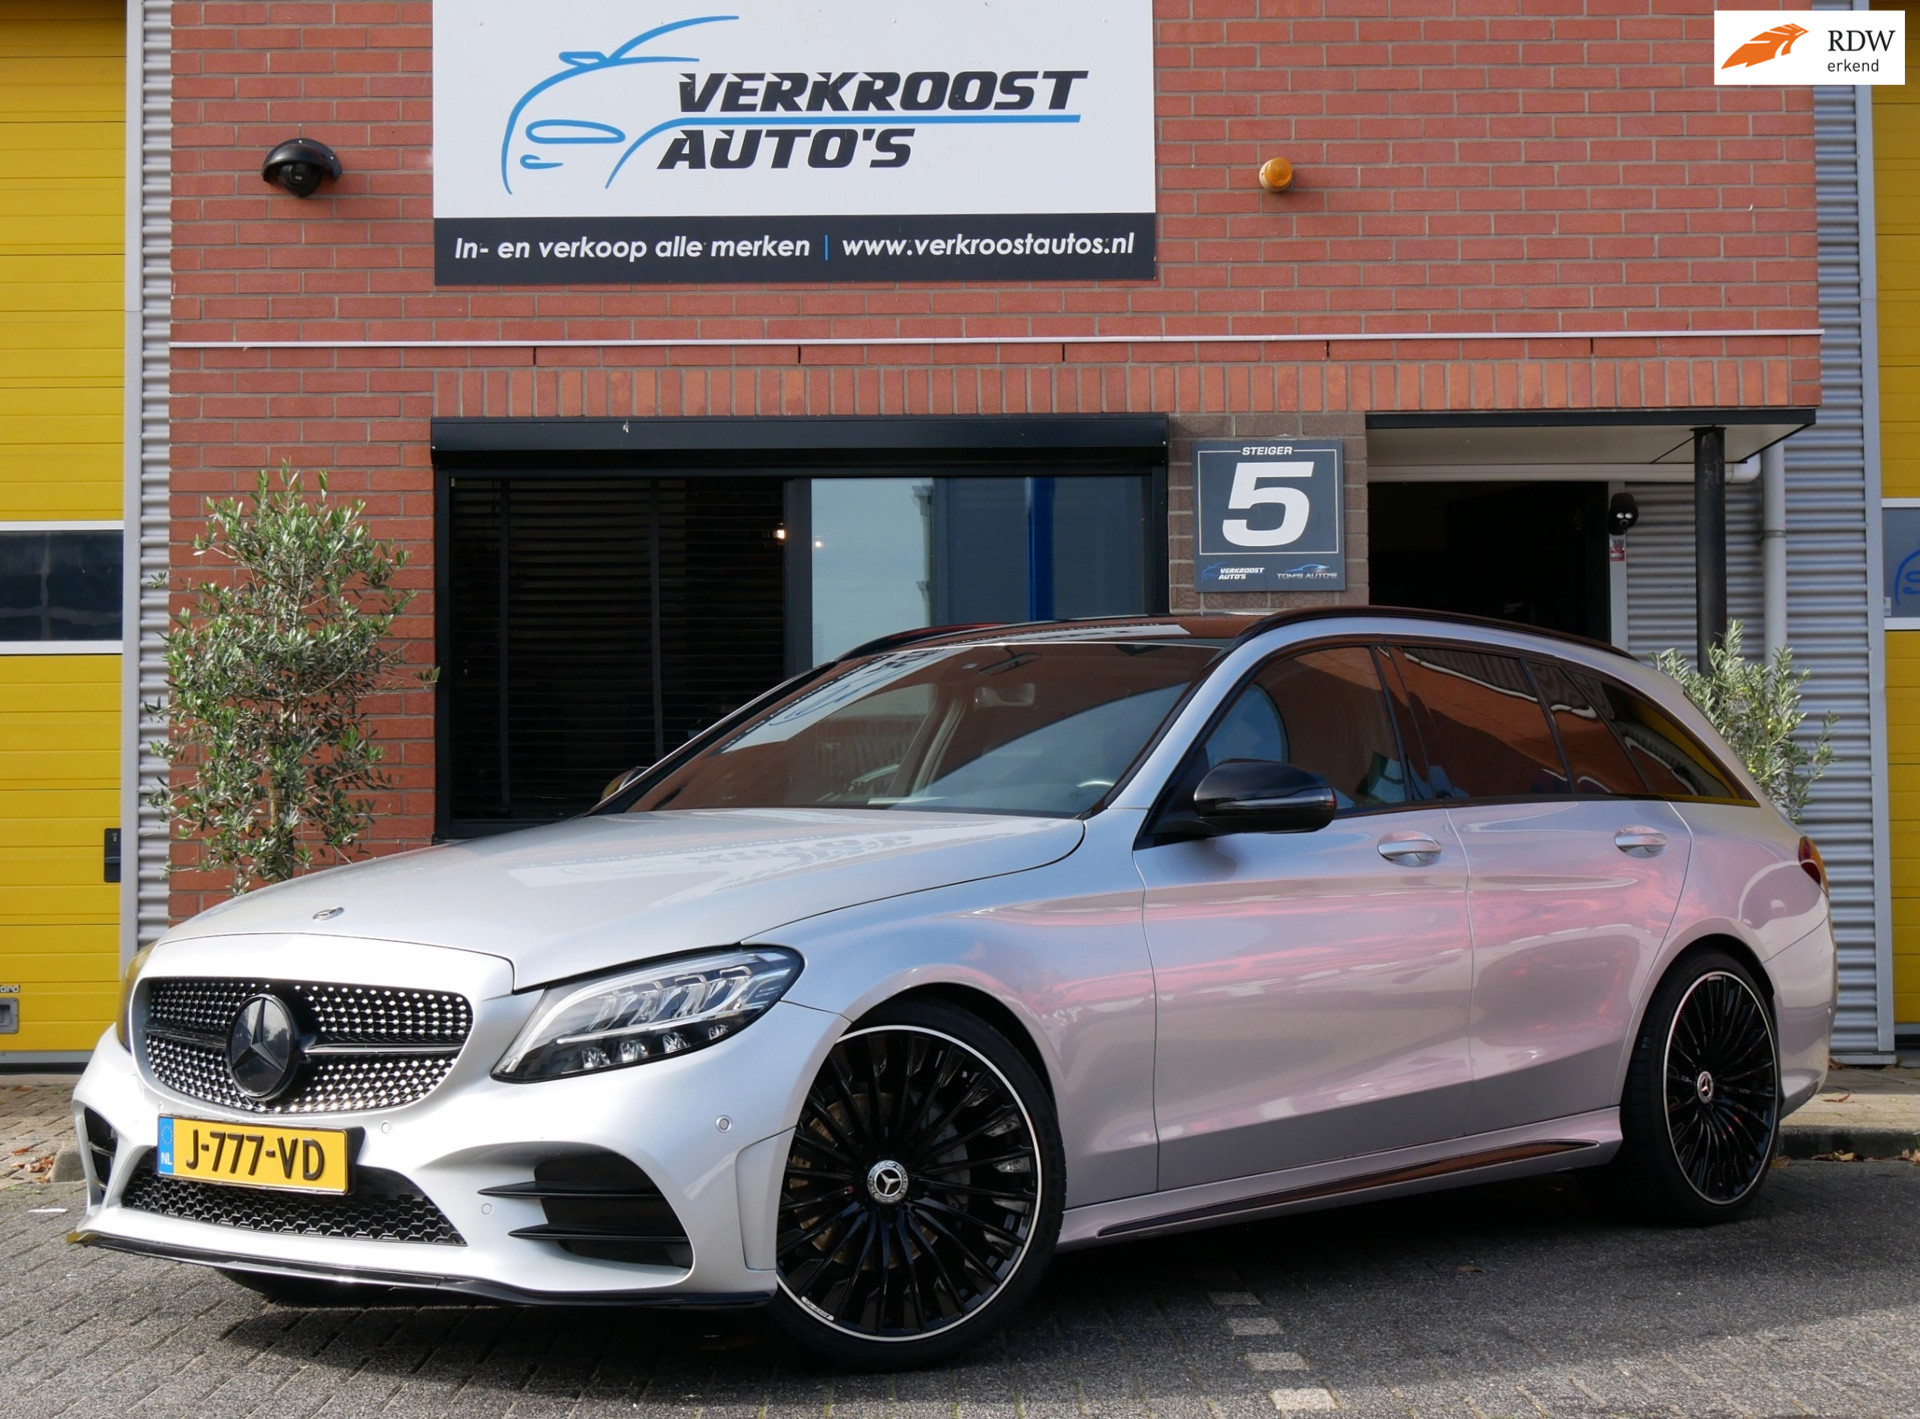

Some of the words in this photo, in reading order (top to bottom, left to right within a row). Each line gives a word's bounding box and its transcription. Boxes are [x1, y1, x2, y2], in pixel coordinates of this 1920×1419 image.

[678, 70, 1089, 113] VERKROOST
[656, 128, 915, 170] AUTO'S
[454, 236, 489, 259] In-
[497, 241, 531, 259] en
[538, 236, 648, 263] verkoop
[655, 235, 703, 258] alle
[710, 234, 810, 257] merken
[842, 231, 1135, 256] www.verkroostautos.nl
[1242, 446, 1293, 456] STEIGER
[1222, 461, 1315, 547] 5
[0, 984, 19, 993] ord
[160, 1151, 173, 1166] NL
[185, 1128, 326, 1181] J-777-VD
